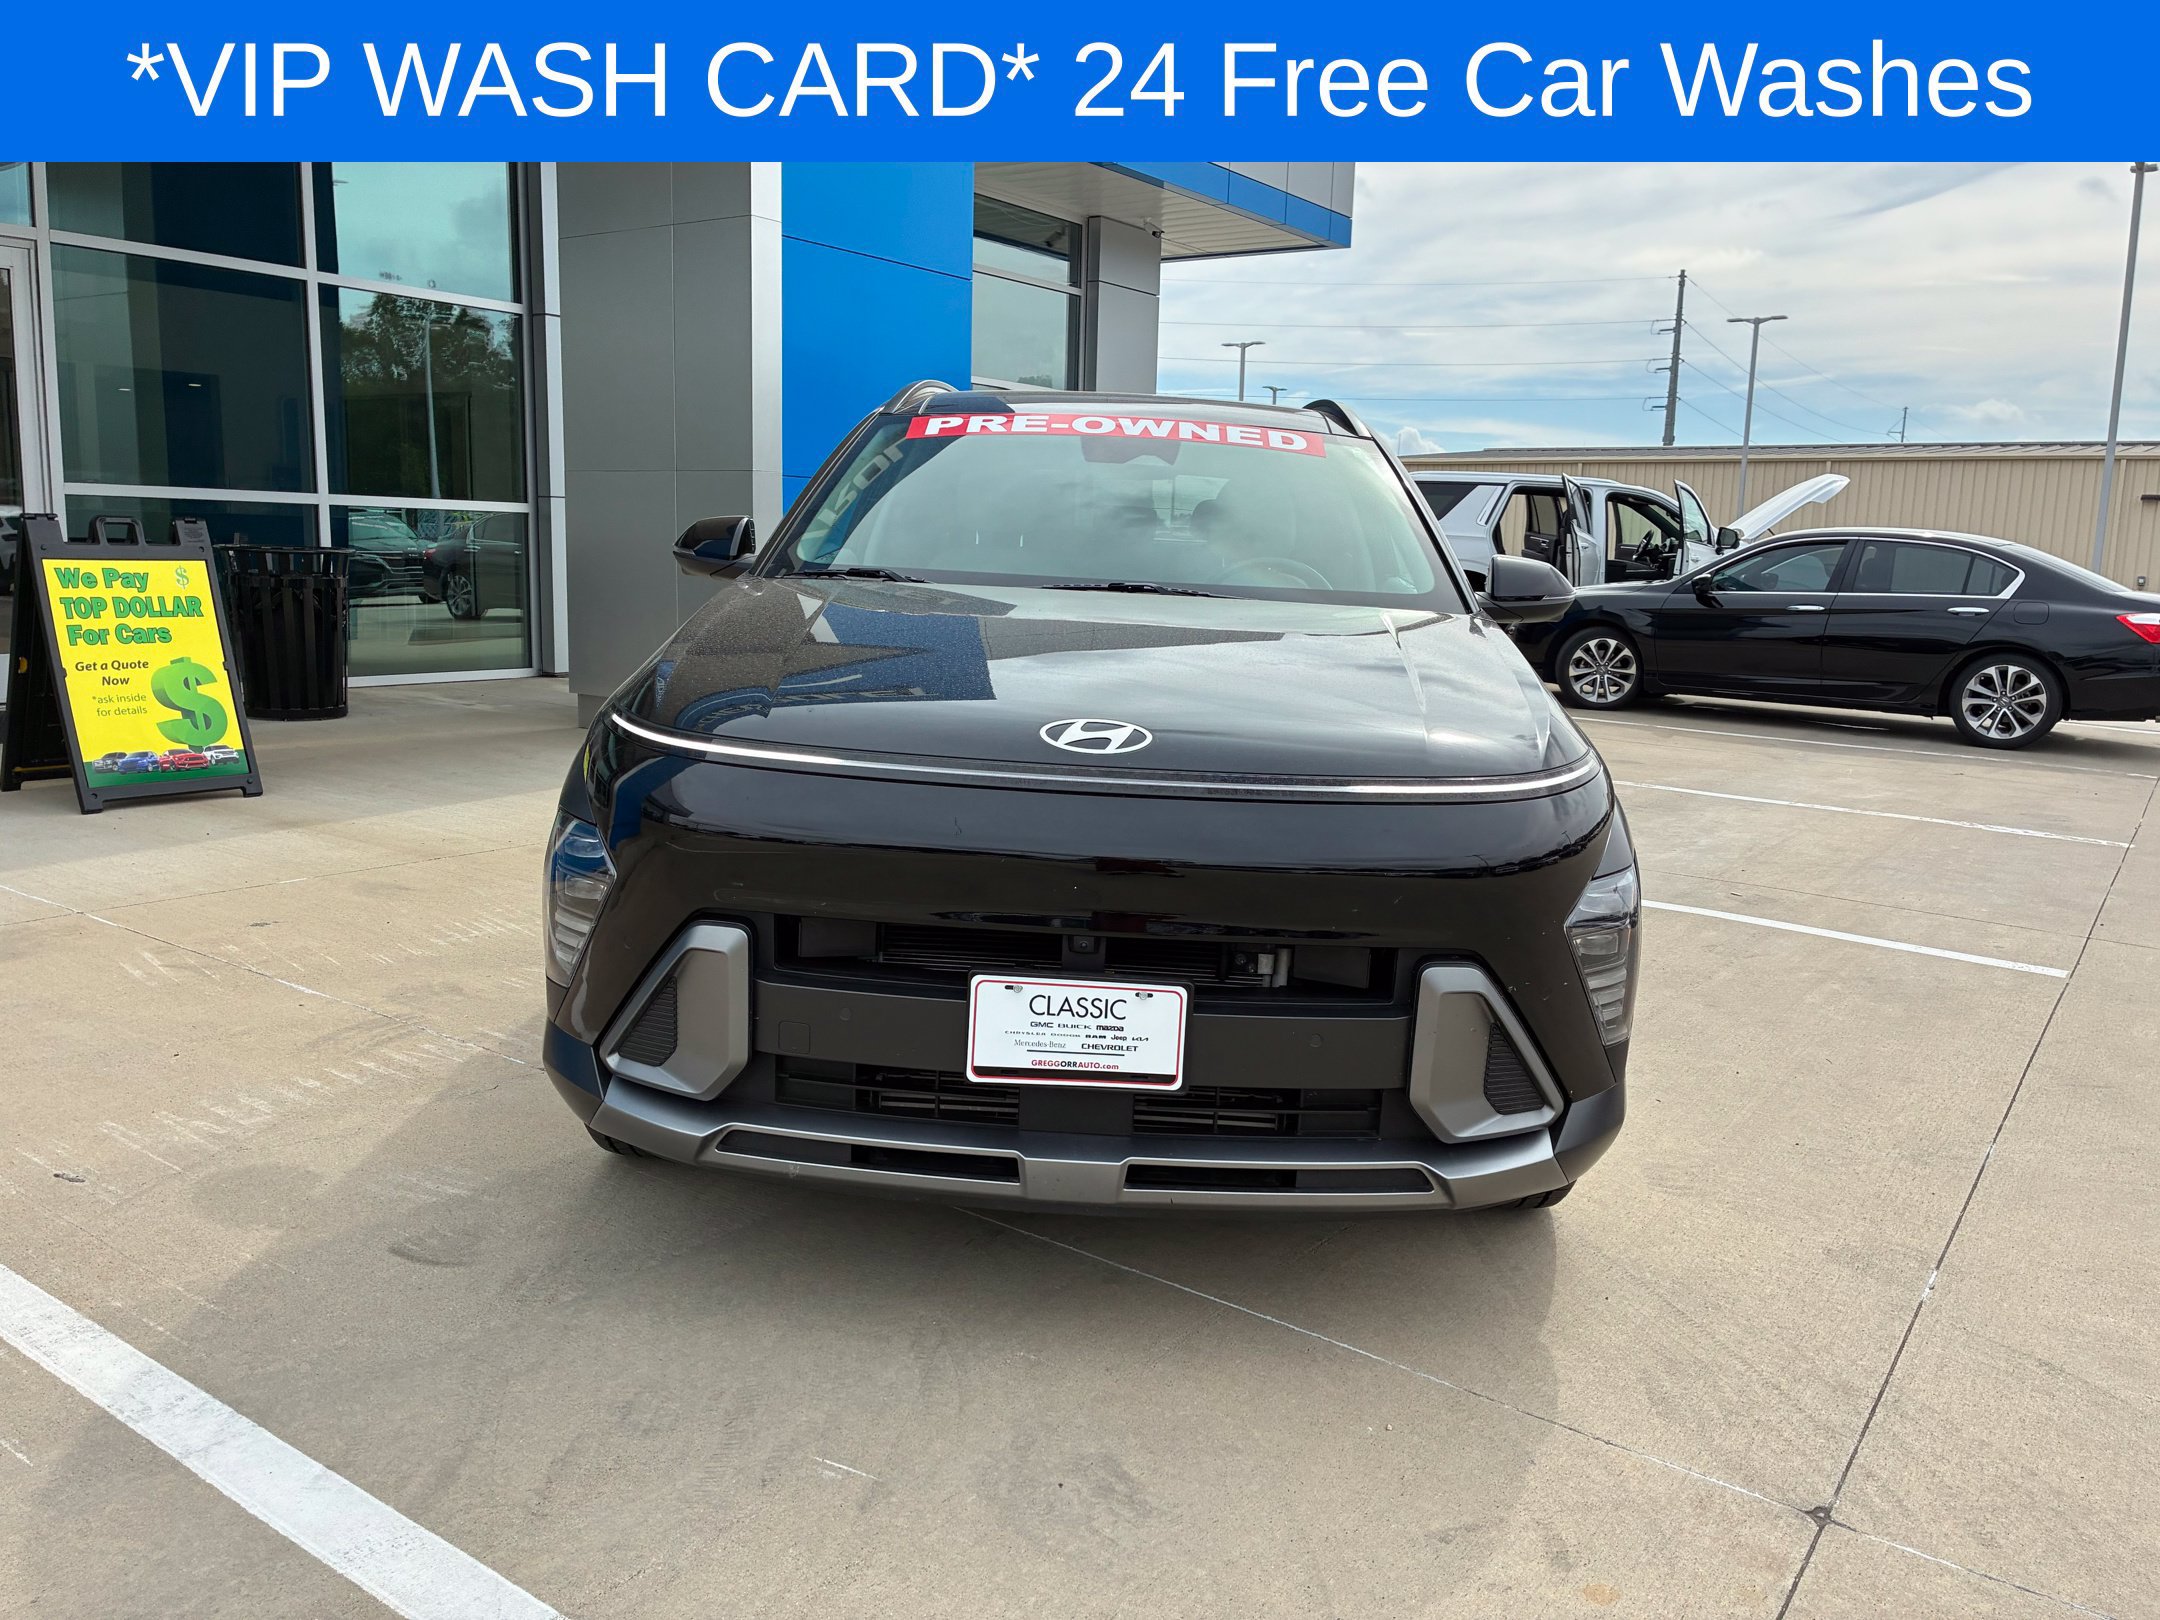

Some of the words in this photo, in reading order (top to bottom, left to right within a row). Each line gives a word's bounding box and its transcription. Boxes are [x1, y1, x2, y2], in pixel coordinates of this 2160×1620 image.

[924, 415, 1308, 452] PRE-OWNED
[54, 567, 98, 589] We
[103, 567, 149, 593] Pay
[60, 597, 107, 619] TOP
[112, 596, 204, 618] DOLLAR
[66, 625, 110, 646] For
[115, 624, 172, 644] Cars
[75, 661, 97, 672] Get
[100, 662, 108, 671] a
[111, 660, 149, 672] Quote
[102, 676, 130, 686] Now
[117, 693, 147, 703] inside
[96, 707, 111, 717] for
[114, 706, 148, 716] details
[1029, 994, 1127, 1020] CLASSIC
[1014, 1039, 1066, 1049] Mercedes-Benz
[1081, 1043, 1138, 1052] CHEVROLET
[1031, 1059, 1119, 1070] GREGGORRAUTO.com
